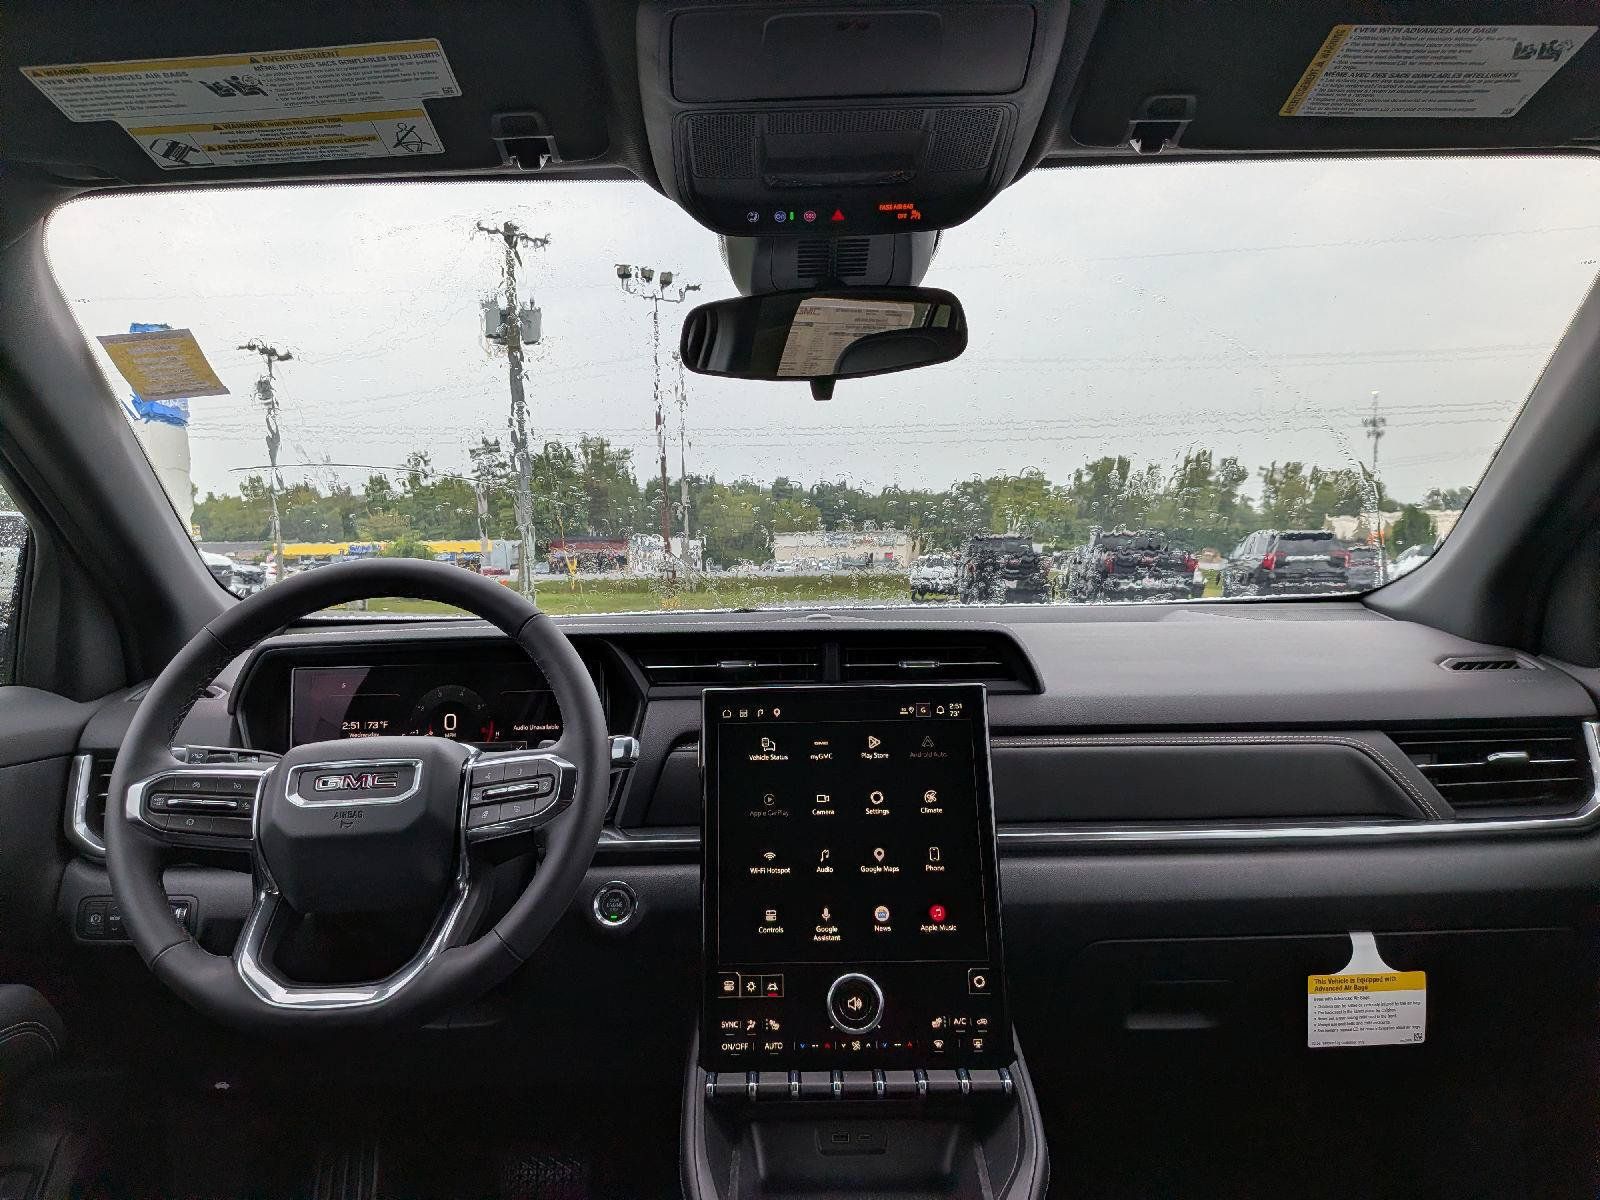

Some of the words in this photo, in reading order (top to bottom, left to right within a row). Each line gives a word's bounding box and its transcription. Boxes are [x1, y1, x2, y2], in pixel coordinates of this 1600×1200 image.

[444, 714, 456, 731] 0
[861, 752, 874, 760] Play
[314, 772, 398, 791] GMC
[866, 808, 890, 816] Settings
[766, 867, 790, 875] Hotspot
[860, 866, 882, 874] Google
[884, 866, 900, 874] Maps
[816, 926, 838, 934] Google
[920, 924, 938, 932] Apple
[1356, 977, 1384, 985] Equipped
[721, 1020, 739, 1028] SYNC
[721, 1042, 749, 1051] ON/OFF
[764, 1042, 784, 1051] AUTO
